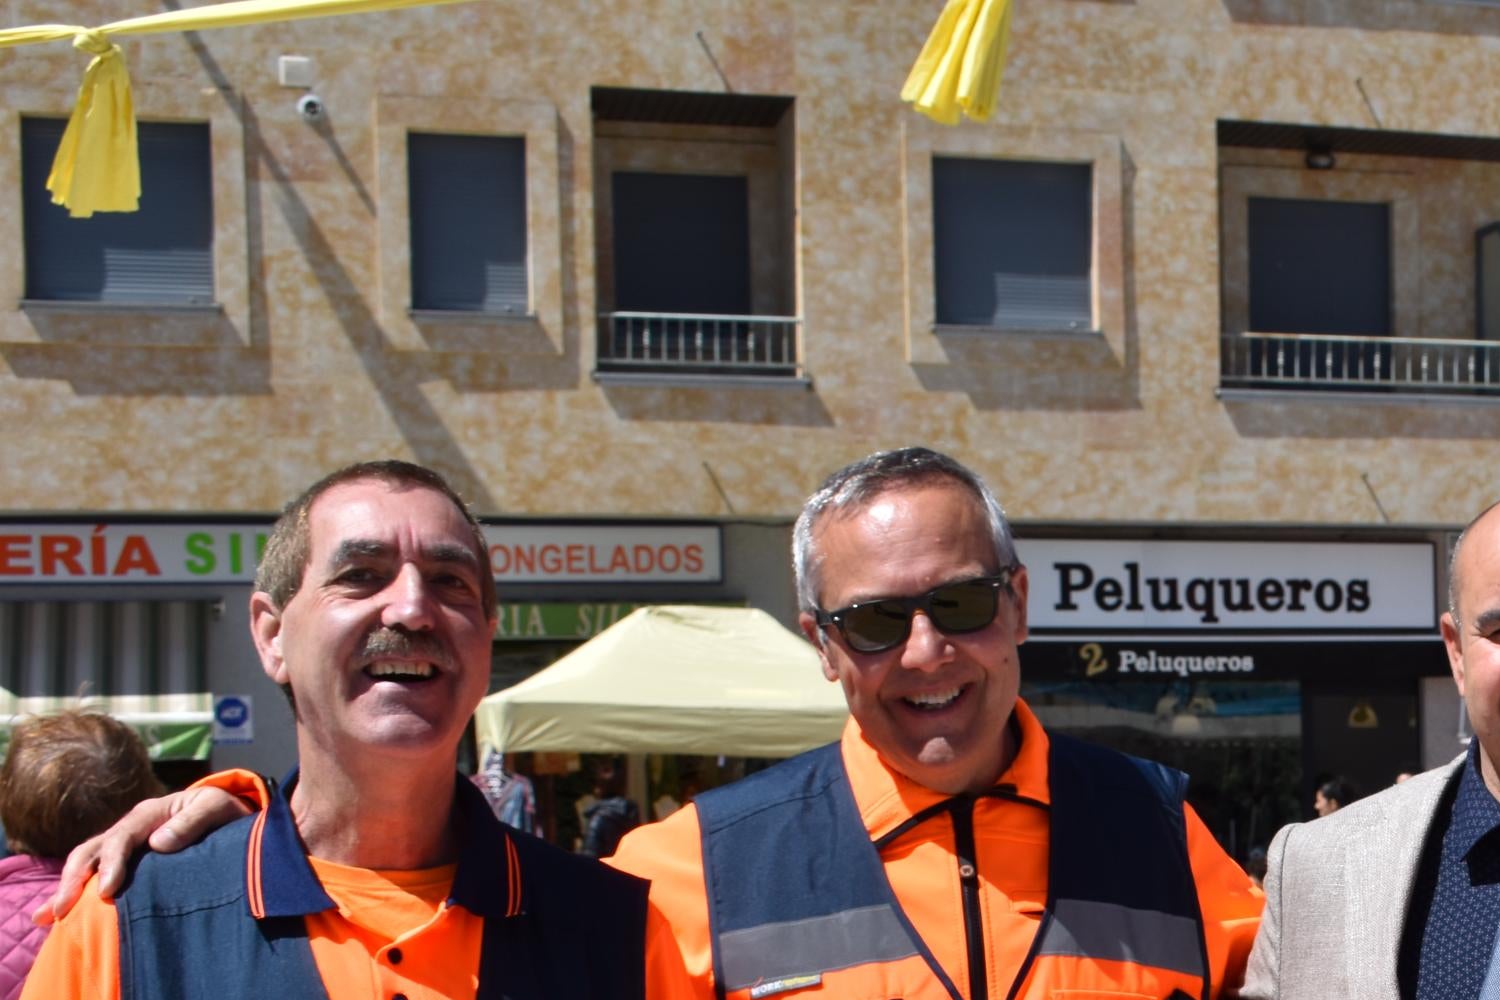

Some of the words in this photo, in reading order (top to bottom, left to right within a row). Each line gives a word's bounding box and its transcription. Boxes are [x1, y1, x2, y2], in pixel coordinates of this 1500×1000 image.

[1053, 561, 1371, 623] Peluqueros
[1079, 643, 1109, 677] 2
[1118, 651, 1254, 674] Peluqueros
